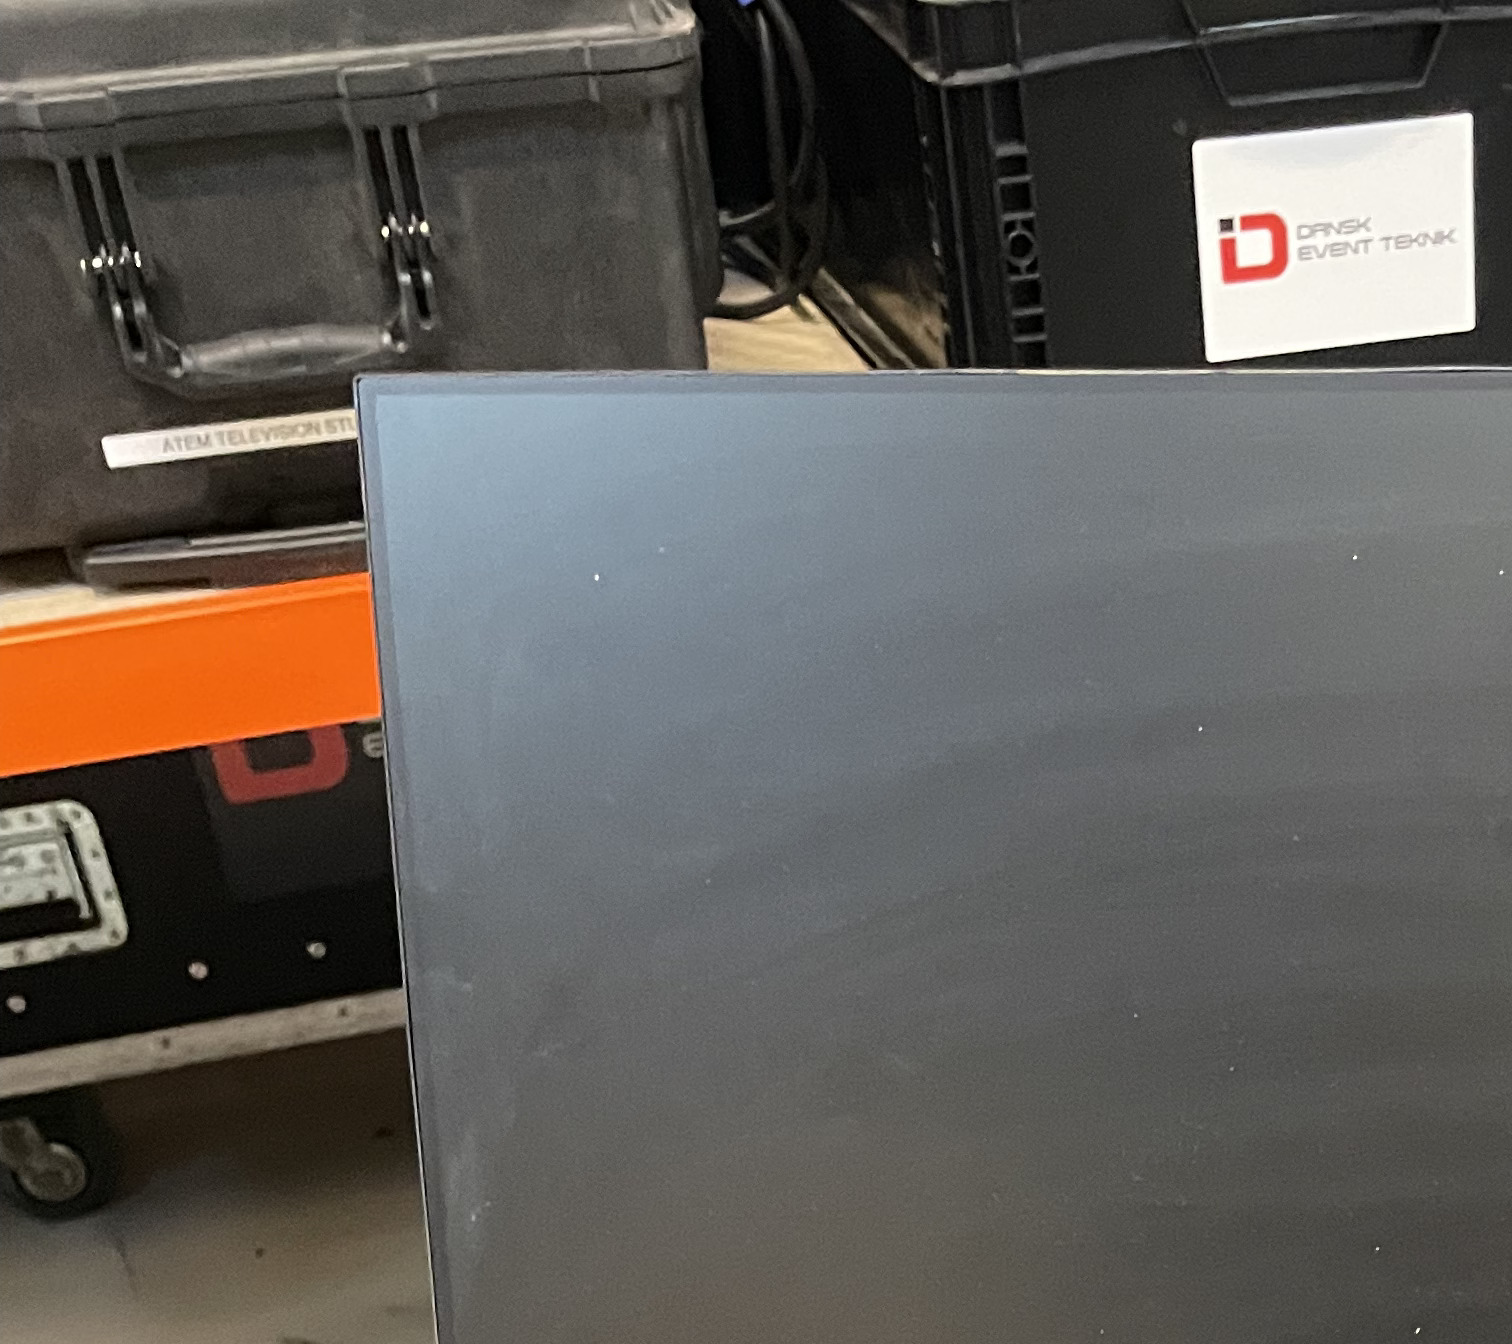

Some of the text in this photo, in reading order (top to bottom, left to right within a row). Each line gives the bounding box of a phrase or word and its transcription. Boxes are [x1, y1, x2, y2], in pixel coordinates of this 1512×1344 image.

[1297, 216, 1371, 240] DANSK
[1297, 228, 1458, 261] EVENT TEKNIK
[162, 434, 213, 454] ATEM
[214, 420, 321, 447] TELEVISION
